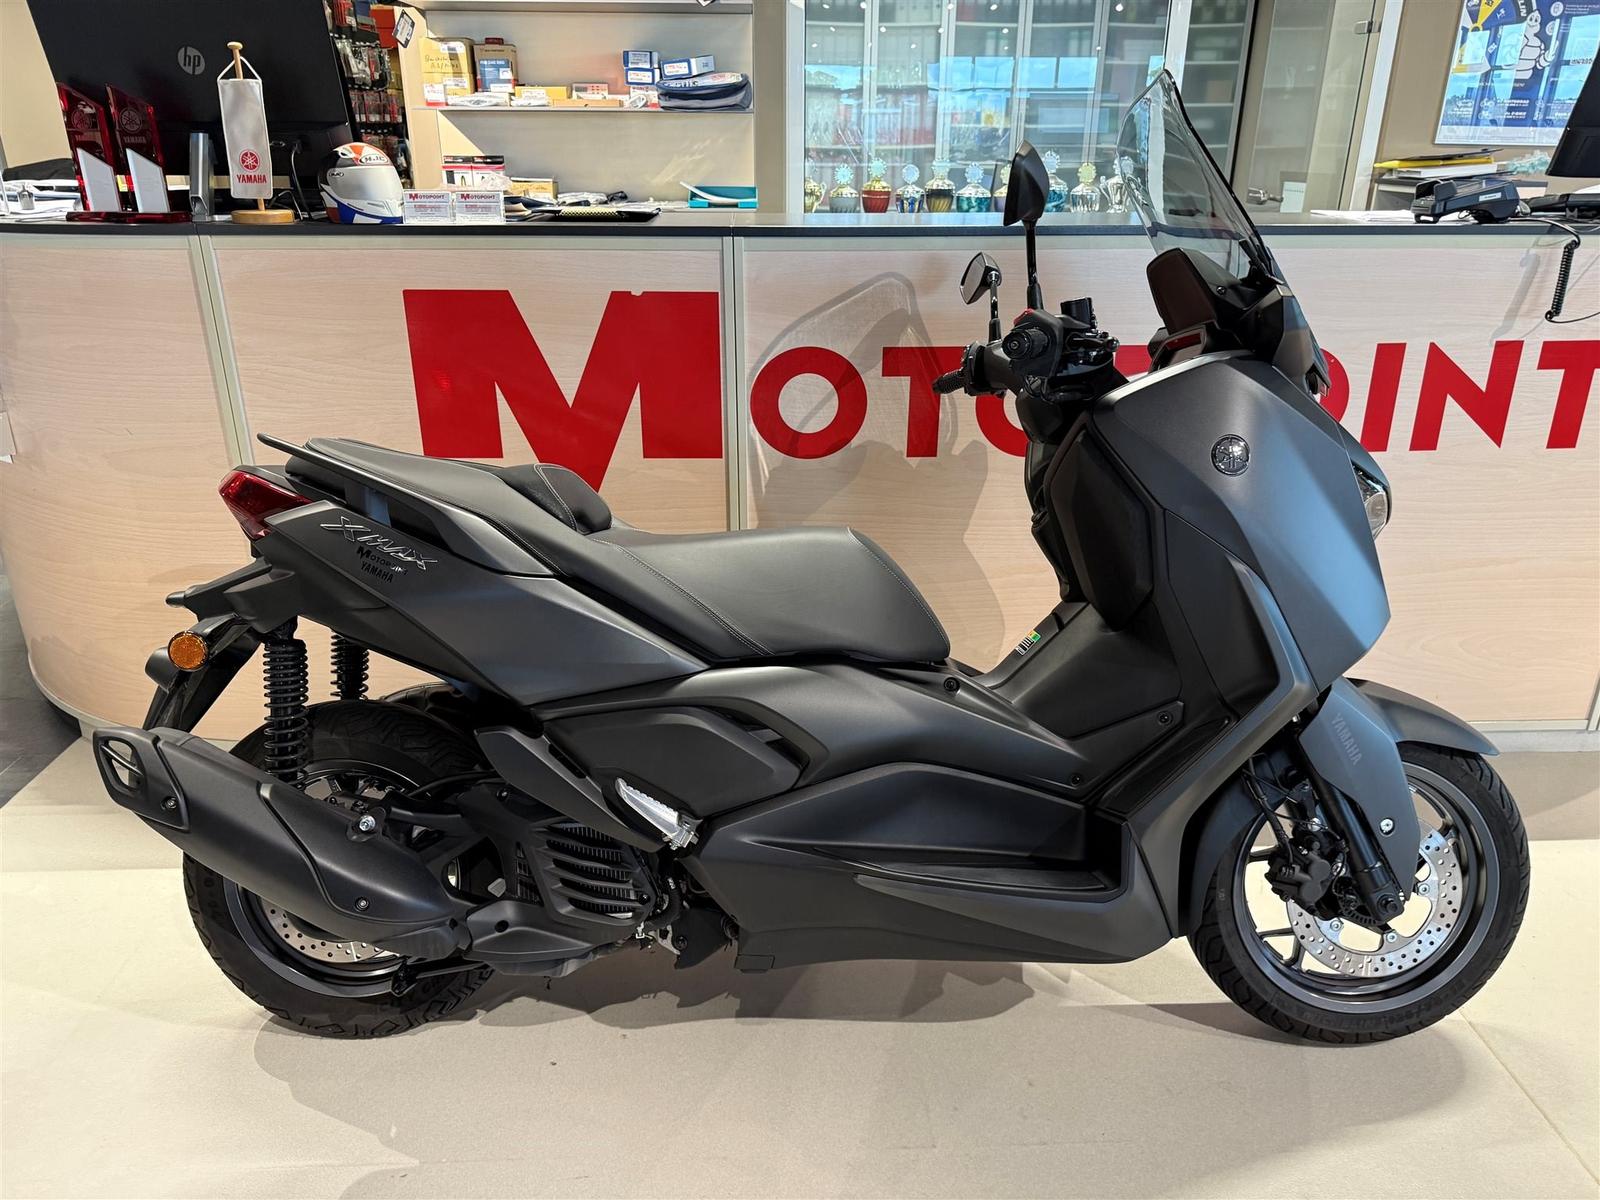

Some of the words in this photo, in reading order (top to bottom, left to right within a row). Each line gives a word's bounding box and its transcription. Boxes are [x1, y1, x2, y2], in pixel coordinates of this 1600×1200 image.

[182, 46, 202, 75] hp
[236, 174, 267, 184] YAMAHA
[356, 545, 409, 575] MOTOPT
[361, 560, 394, 583] YAMAHA
[1331, 712, 1362, 766] YAMAHA
